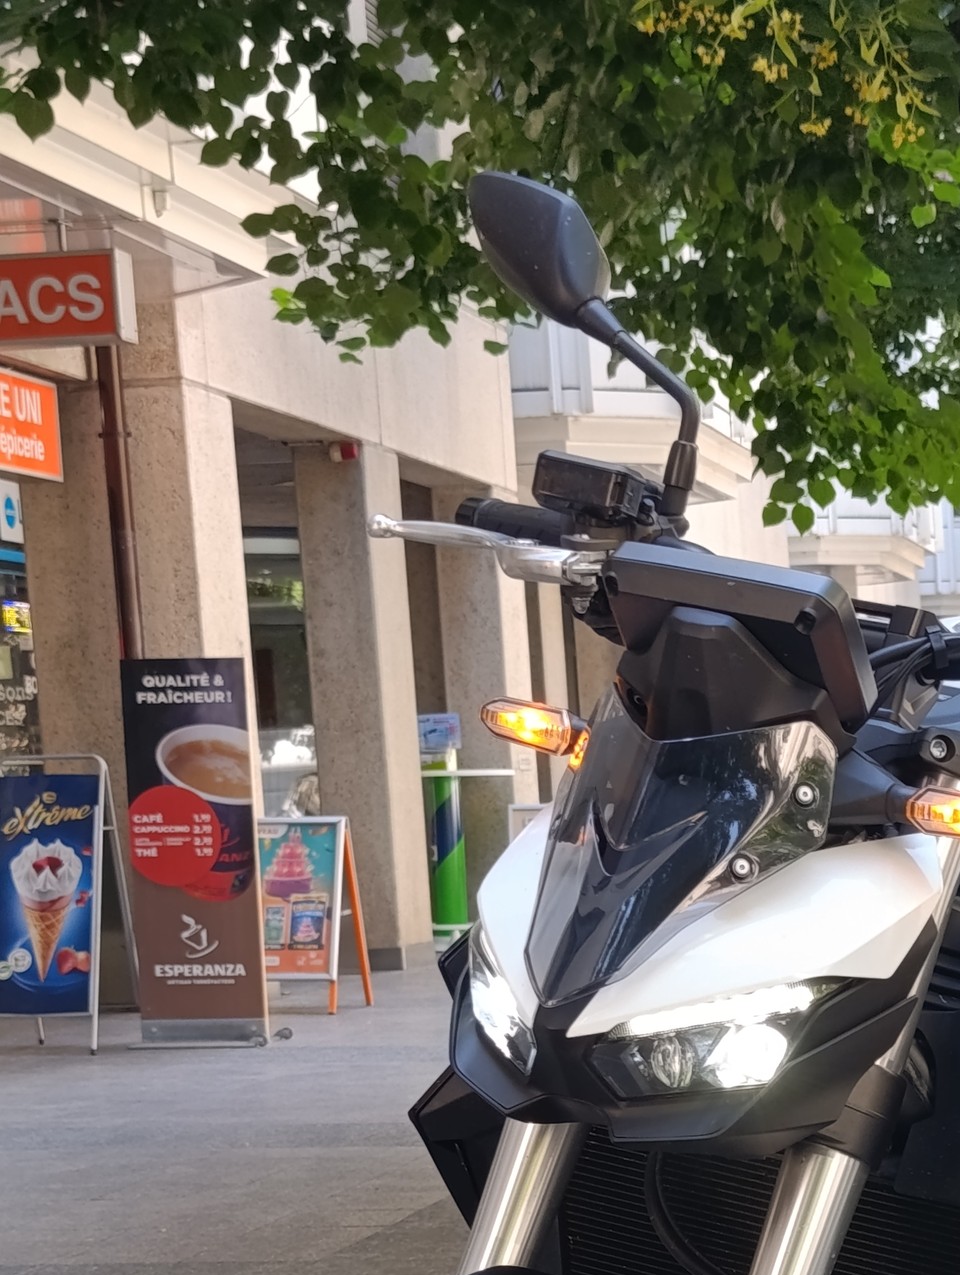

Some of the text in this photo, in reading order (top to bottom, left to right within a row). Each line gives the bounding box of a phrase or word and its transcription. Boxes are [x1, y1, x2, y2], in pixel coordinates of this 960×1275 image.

[14, 387, 43, 425] UNI
[0, 425, 45, 462] épicerie
[142, 672, 224, 688] QUALITÉ &
[133, 813, 163, 823] CAFÉ
[133, 825, 190, 833] CAPPUCCINO
[135, 847, 158, 857] THÉ
[154, 963, 246, 977] ESPERANZA
